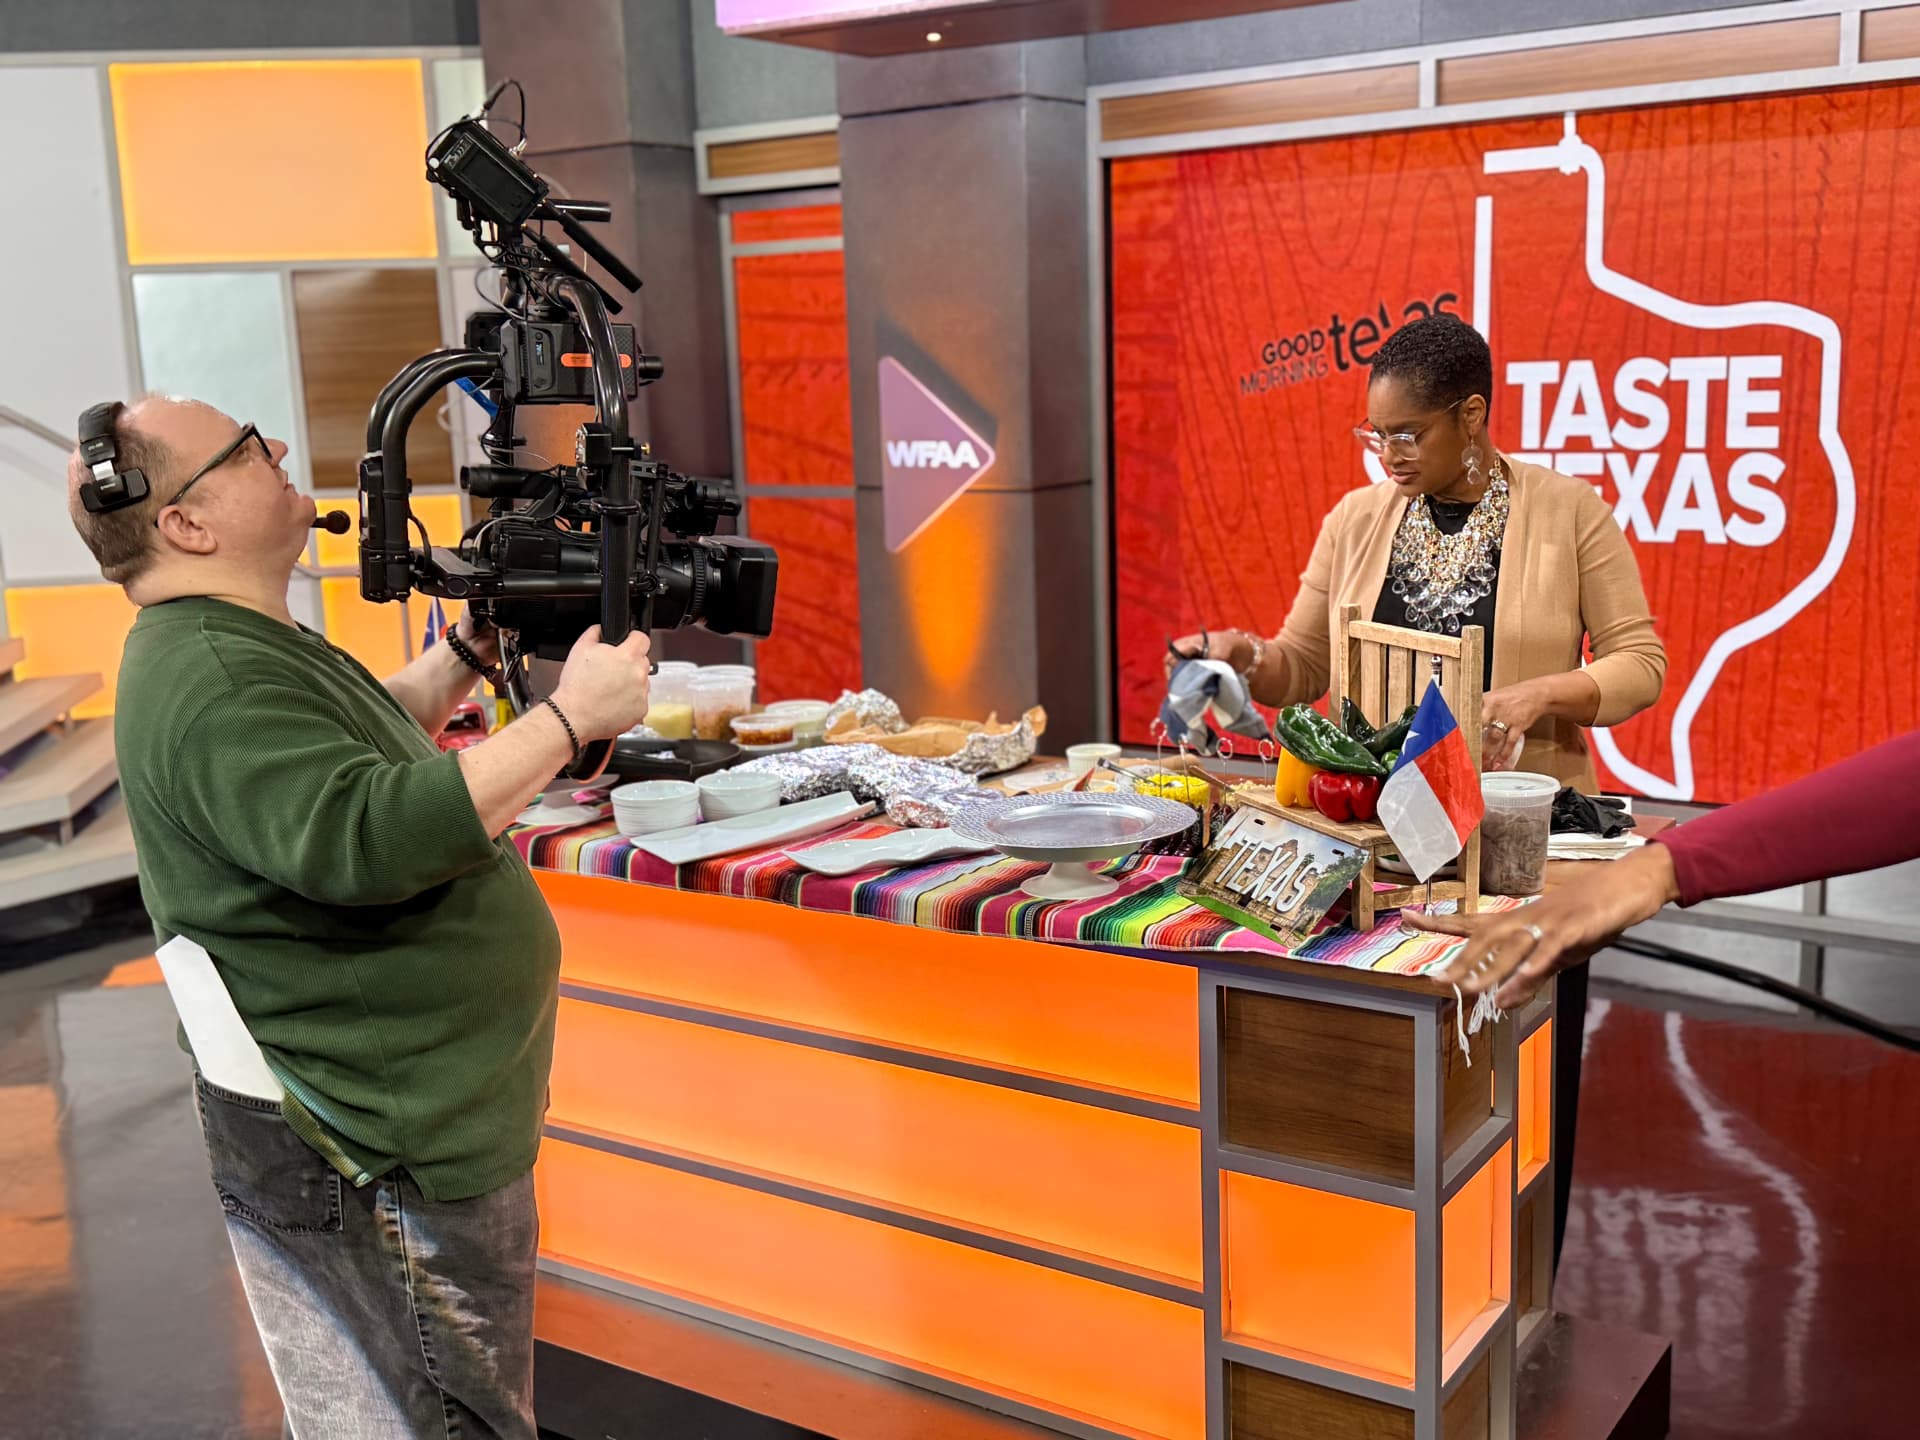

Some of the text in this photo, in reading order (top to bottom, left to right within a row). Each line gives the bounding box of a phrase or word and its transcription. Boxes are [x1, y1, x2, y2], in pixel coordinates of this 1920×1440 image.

[1262, 329, 1325, 365] GOOD
[1328, 292, 1458, 371] tes
[1239, 354, 1328, 395] MORNING
[1506, 355, 1783, 450] TASTE
[886, 440, 980, 469] WFAA
[1508, 452, 1786, 547] XAS
[1215, 836, 1323, 912] TEXAS
